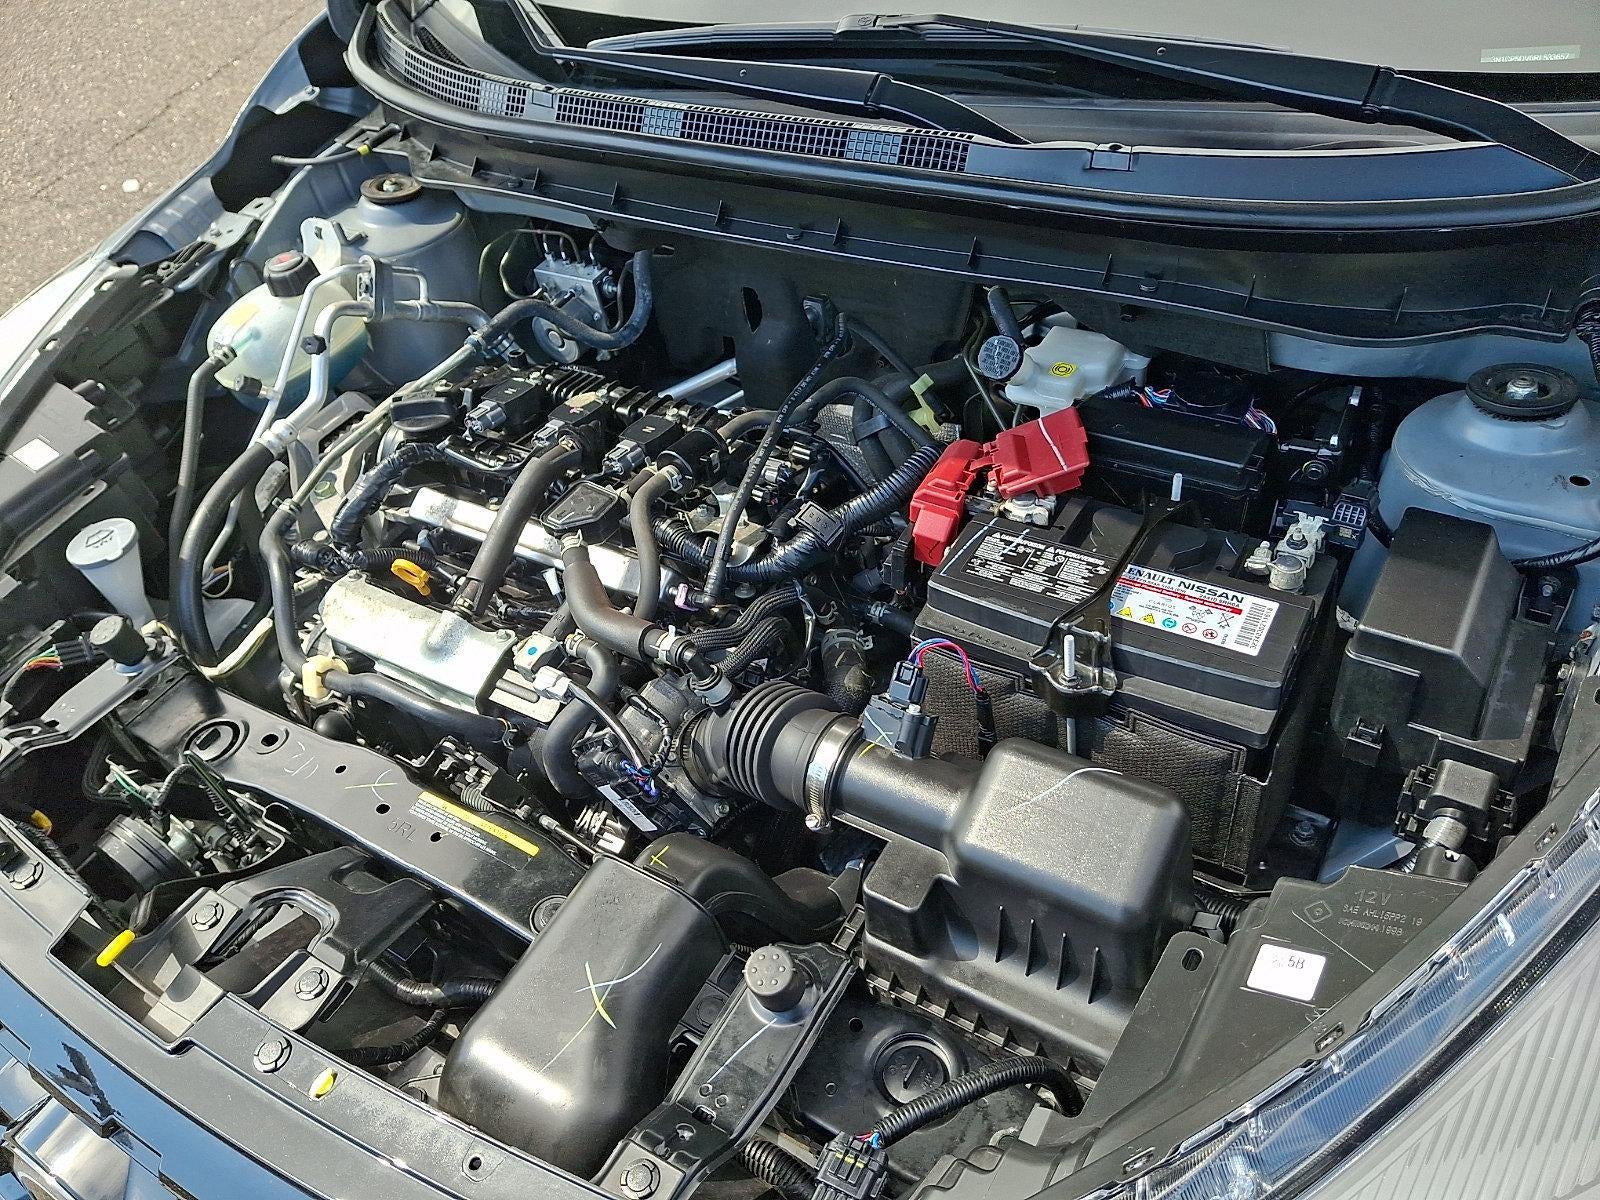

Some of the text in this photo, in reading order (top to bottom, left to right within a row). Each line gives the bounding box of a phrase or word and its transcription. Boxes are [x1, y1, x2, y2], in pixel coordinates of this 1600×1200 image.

[1126, 567, 1176, 586] ENAULT
[1177, 580, 1245, 604] NISSAN
[1342, 903, 1360, 915] SAE
